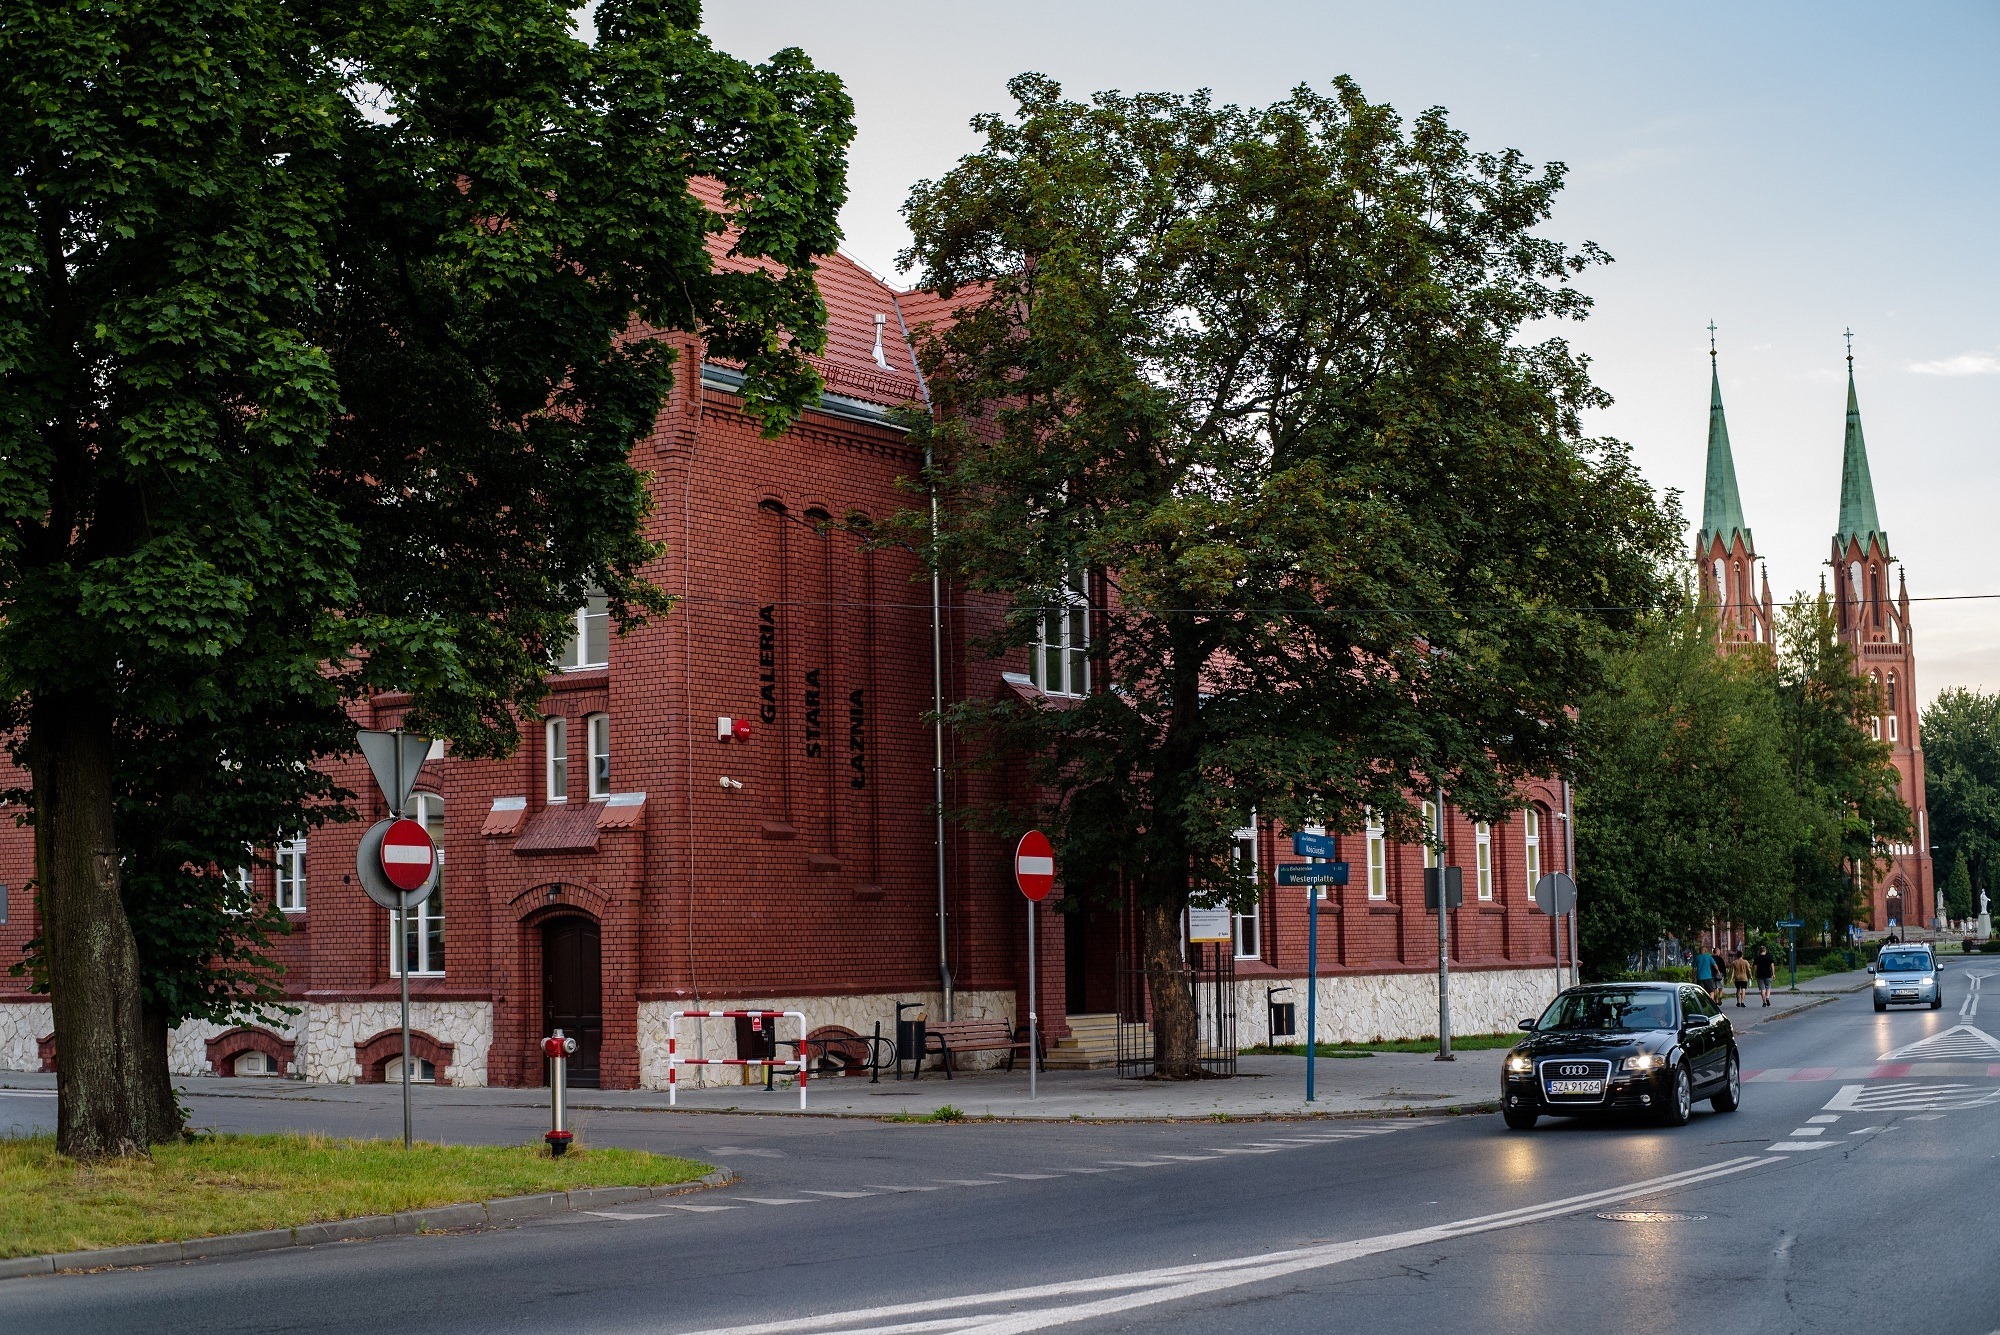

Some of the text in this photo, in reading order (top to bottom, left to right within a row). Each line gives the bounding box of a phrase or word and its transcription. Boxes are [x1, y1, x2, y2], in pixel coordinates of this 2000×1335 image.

[759, 604, 776, 724] GALERIA
[806, 668, 821, 758] STARA
[1289, 874, 1334, 884] Westerplatte
[1552, 1081, 1600, 1092] SZA 91264
